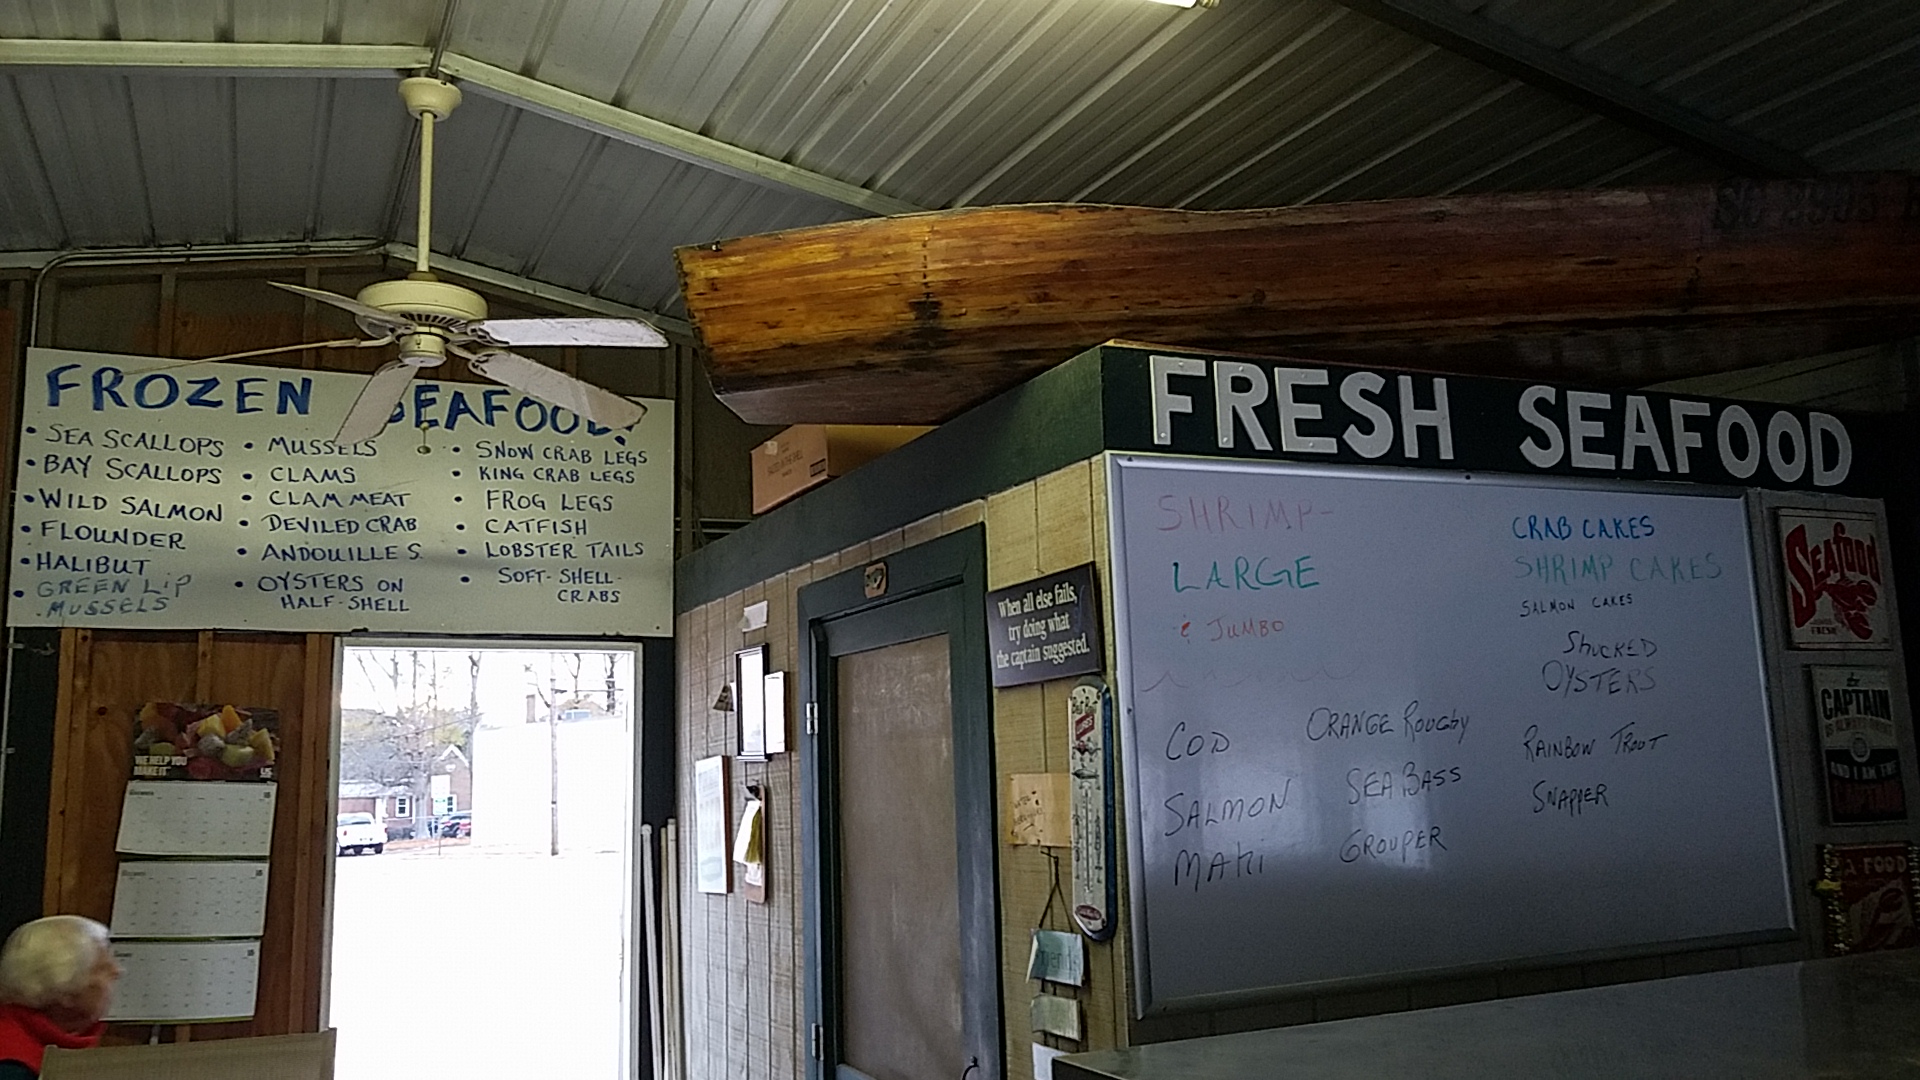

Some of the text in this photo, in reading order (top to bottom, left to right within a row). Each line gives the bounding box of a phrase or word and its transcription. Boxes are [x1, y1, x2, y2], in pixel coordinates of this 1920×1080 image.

[46, 364, 312, 415] FROZEN
[1150, 355, 1851, 486] FRESH SEAFOOD
[46, 424, 224, 457] SEA SCALLOPS
[268, 437, 377, 456] MUSSELS
[476, 441, 647, 466] SNOW CRAB LEGS
[44, 454, 222, 484] BAY SCALLOPS
[270, 467, 356, 483] CLAMS
[479, 466, 635, 483] KING CRAB LEGS
[39, 488, 223, 521] WILD SALMON
[269, 491, 411, 508] CLAM MEAT
[487, 490, 613, 512] FROG LEGS
[41, 520, 186, 549] FLOUNDER
[261, 514, 417, 534] DEVILED CRAB
[486, 519, 587, 535] CATFISH
[1513, 515, 1654, 541] CRAB CAKES
[37, 553, 150, 575] HALIBUT
[261, 544, 398, 561] ANDOUILLE
[486, 543, 644, 560] LOBSTER TAILS
[257, 571, 403, 593] OYSTERS ON
[1173, 555, 1320, 592] LARGE
[1514, 553, 1722, 586] SHRIMP CAKES
[37, 577, 129, 598] GREEN
[557, 590, 620, 603] CRABS
[998, 582, 1078, 618] When all else fails,
[47, 597, 170, 618] MUSSELS
[1521, 593, 1633, 617] SALMON CAKES
[1008, 612, 1070, 645] try doing what
[1207, 615, 1284, 641] JUMBO
[996, 632, 1090, 670] the captain suggested.
[1542, 660, 1656, 698] OYSTERS
[1821, 688, 1892, 720] CAPTAIN
[1307, 707, 1394, 740] ORANGE
[1166, 722, 1230, 760] COD
[1524, 722, 1668, 762] RAINBOW TROUT
[149, 755, 170, 765] HELP
[171, 756, 187, 766] YOU
[1347, 762, 1461, 804] SEA BASS
[1165, 779, 1291, 836] SALMON
[1533, 780, 1608, 816] SNAPPER
[1340, 826, 1447, 863] GROUPER
